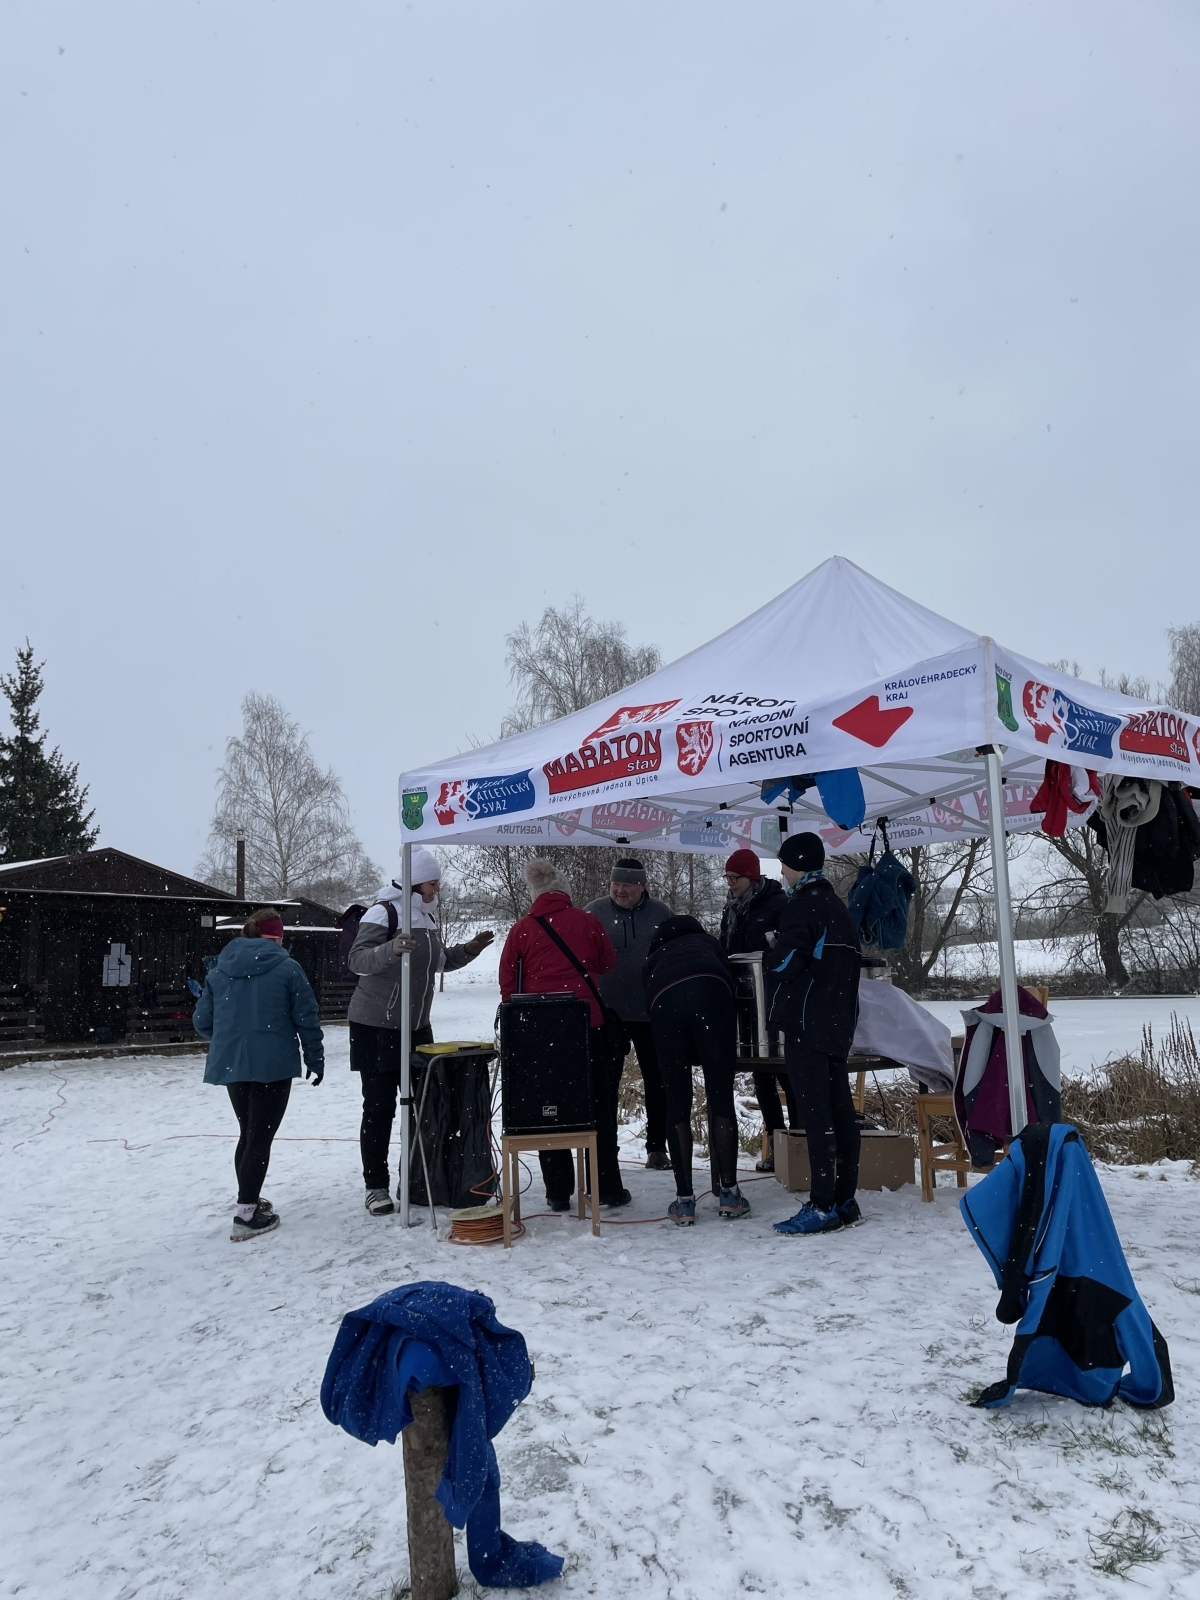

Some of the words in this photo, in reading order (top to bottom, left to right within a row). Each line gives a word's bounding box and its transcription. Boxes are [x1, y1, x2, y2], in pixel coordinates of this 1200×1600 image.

[885, 664, 977, 691] KRÁLOVÉHRADECKÝ
[886, 691, 909, 702] KRAJ
[728, 705, 797, 729] NÁRODNÍ
[729, 716, 810, 748] SPORTOVNÍ
[1077, 733, 1099, 749] SVAZ
[543, 729, 662, 778] MARATON
[729, 743, 807, 767] AGENTURA
[1170, 743, 1187, 757] stav
[627, 758, 658, 773] stav
[477, 779, 530, 801] ATLETICKÝ
[549, 788, 600, 804] tělovýchovná
[602, 780, 632, 794] jednota
[636, 774, 658, 787] Úpice
[483, 800, 507, 814] SVAZ
